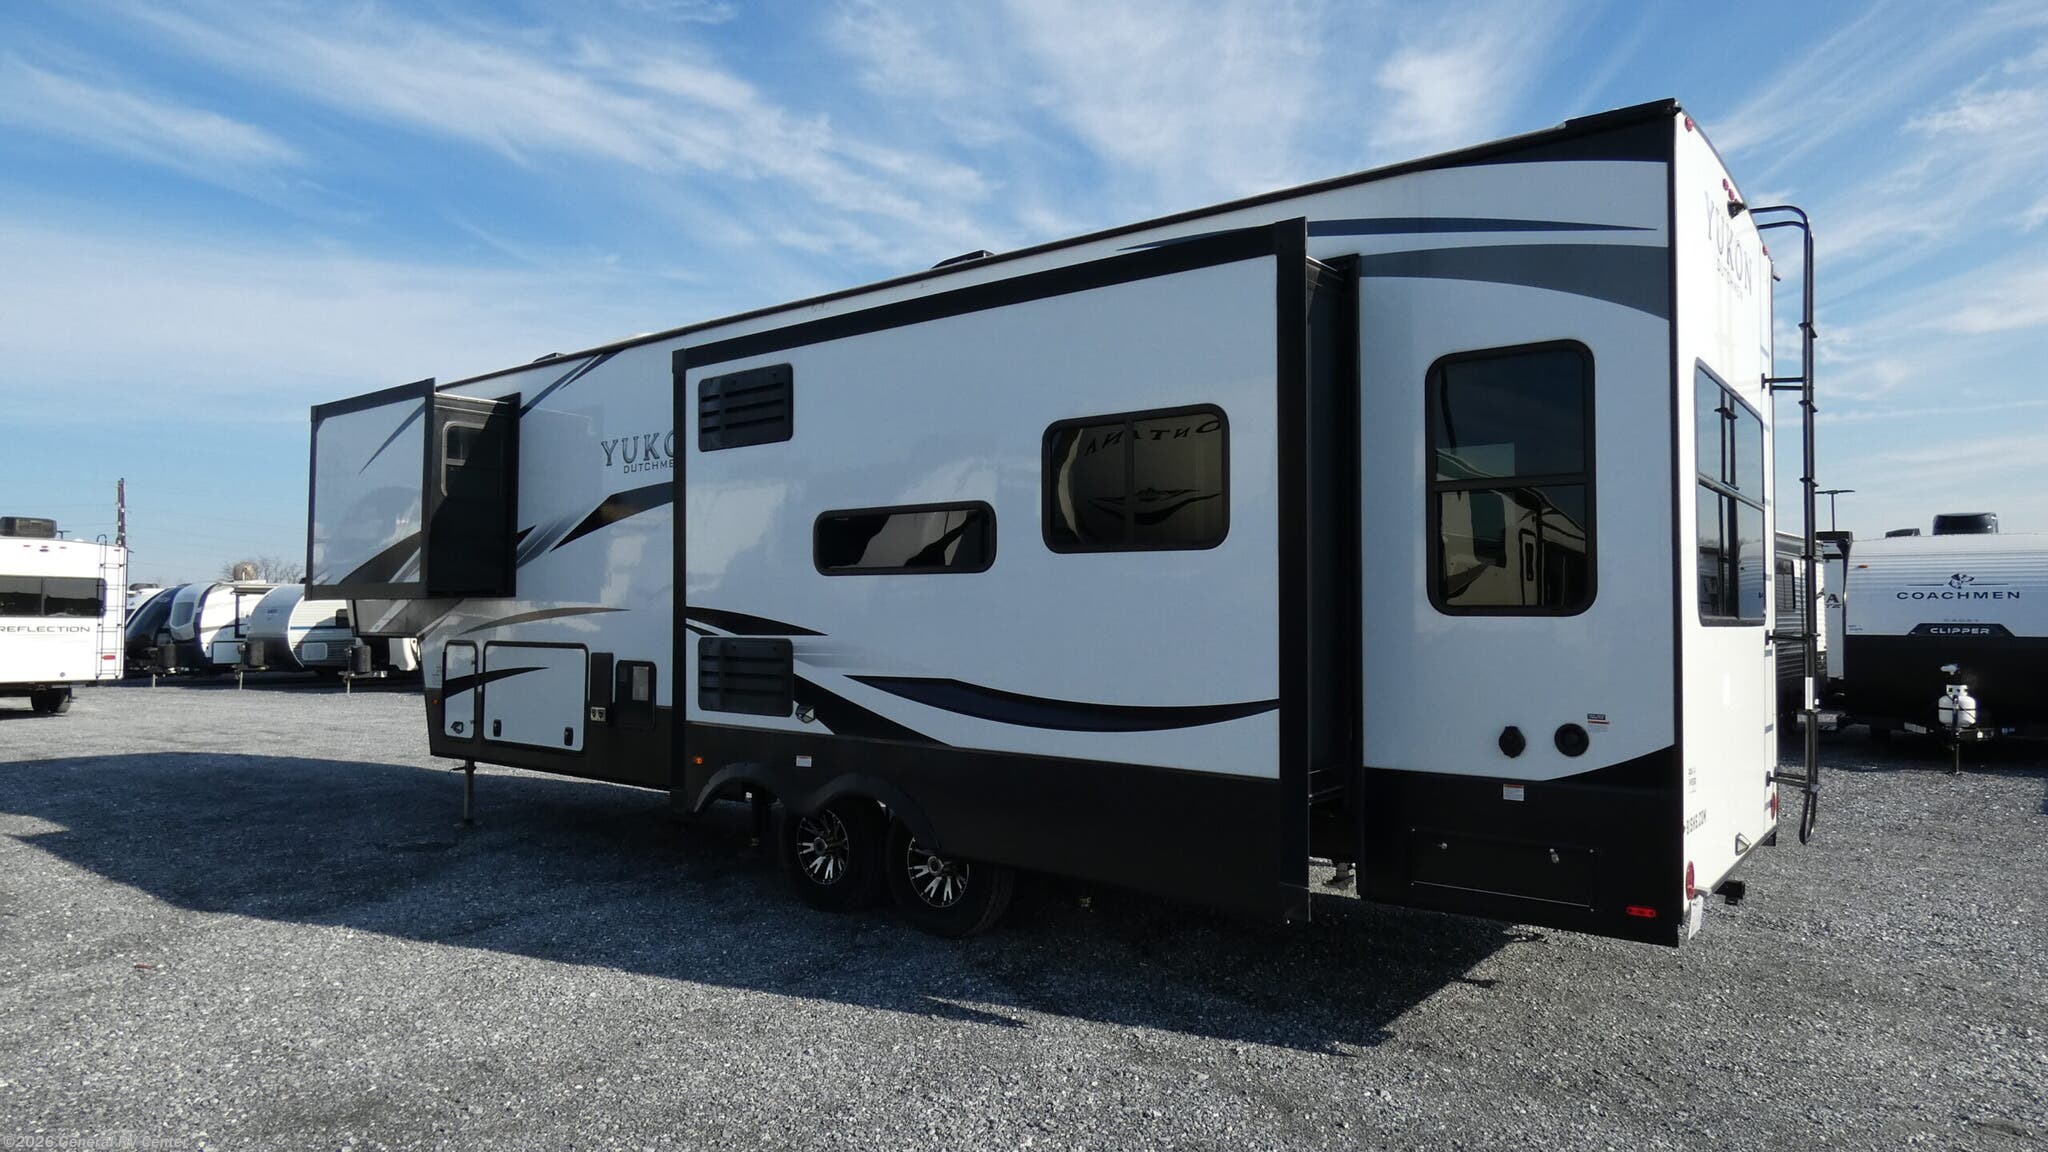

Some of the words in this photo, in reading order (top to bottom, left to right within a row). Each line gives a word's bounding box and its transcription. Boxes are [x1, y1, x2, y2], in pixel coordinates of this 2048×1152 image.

[1704, 190, 1752, 296] YUKON
[1896, 591, 2020, 600] COACHMEN
[1929, 627, 1991, 635] CLIPPER
